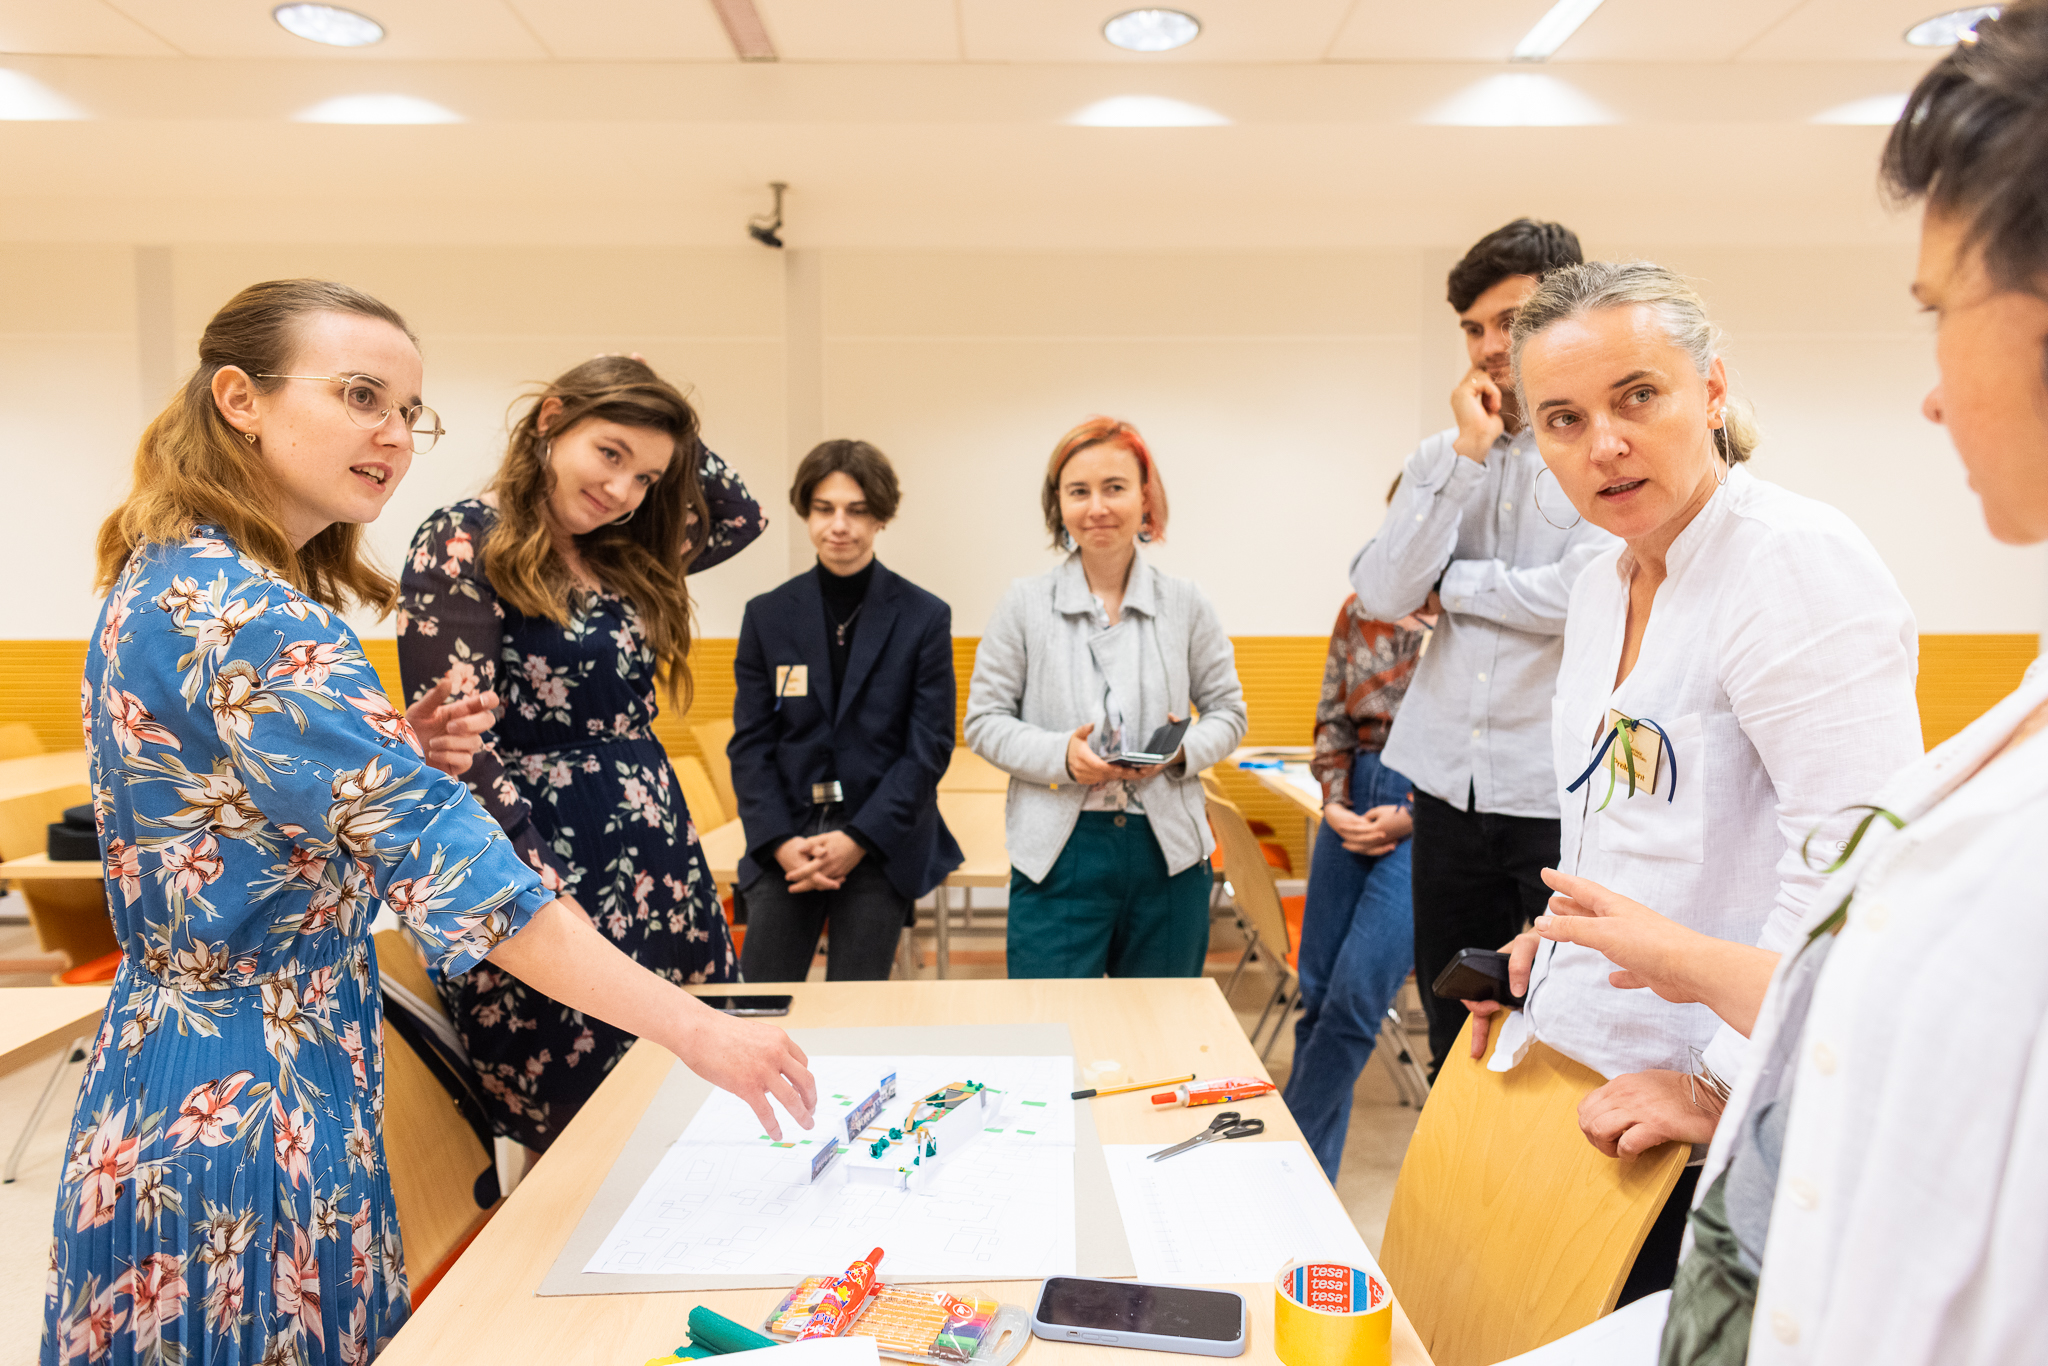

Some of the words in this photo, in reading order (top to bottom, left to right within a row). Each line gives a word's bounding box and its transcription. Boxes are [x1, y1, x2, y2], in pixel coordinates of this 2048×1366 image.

[1310, 1266, 1343, 1278] tesa
[1310, 1278, 1343, 1291] tesa
[1310, 1291, 1343, 1303] tesa
